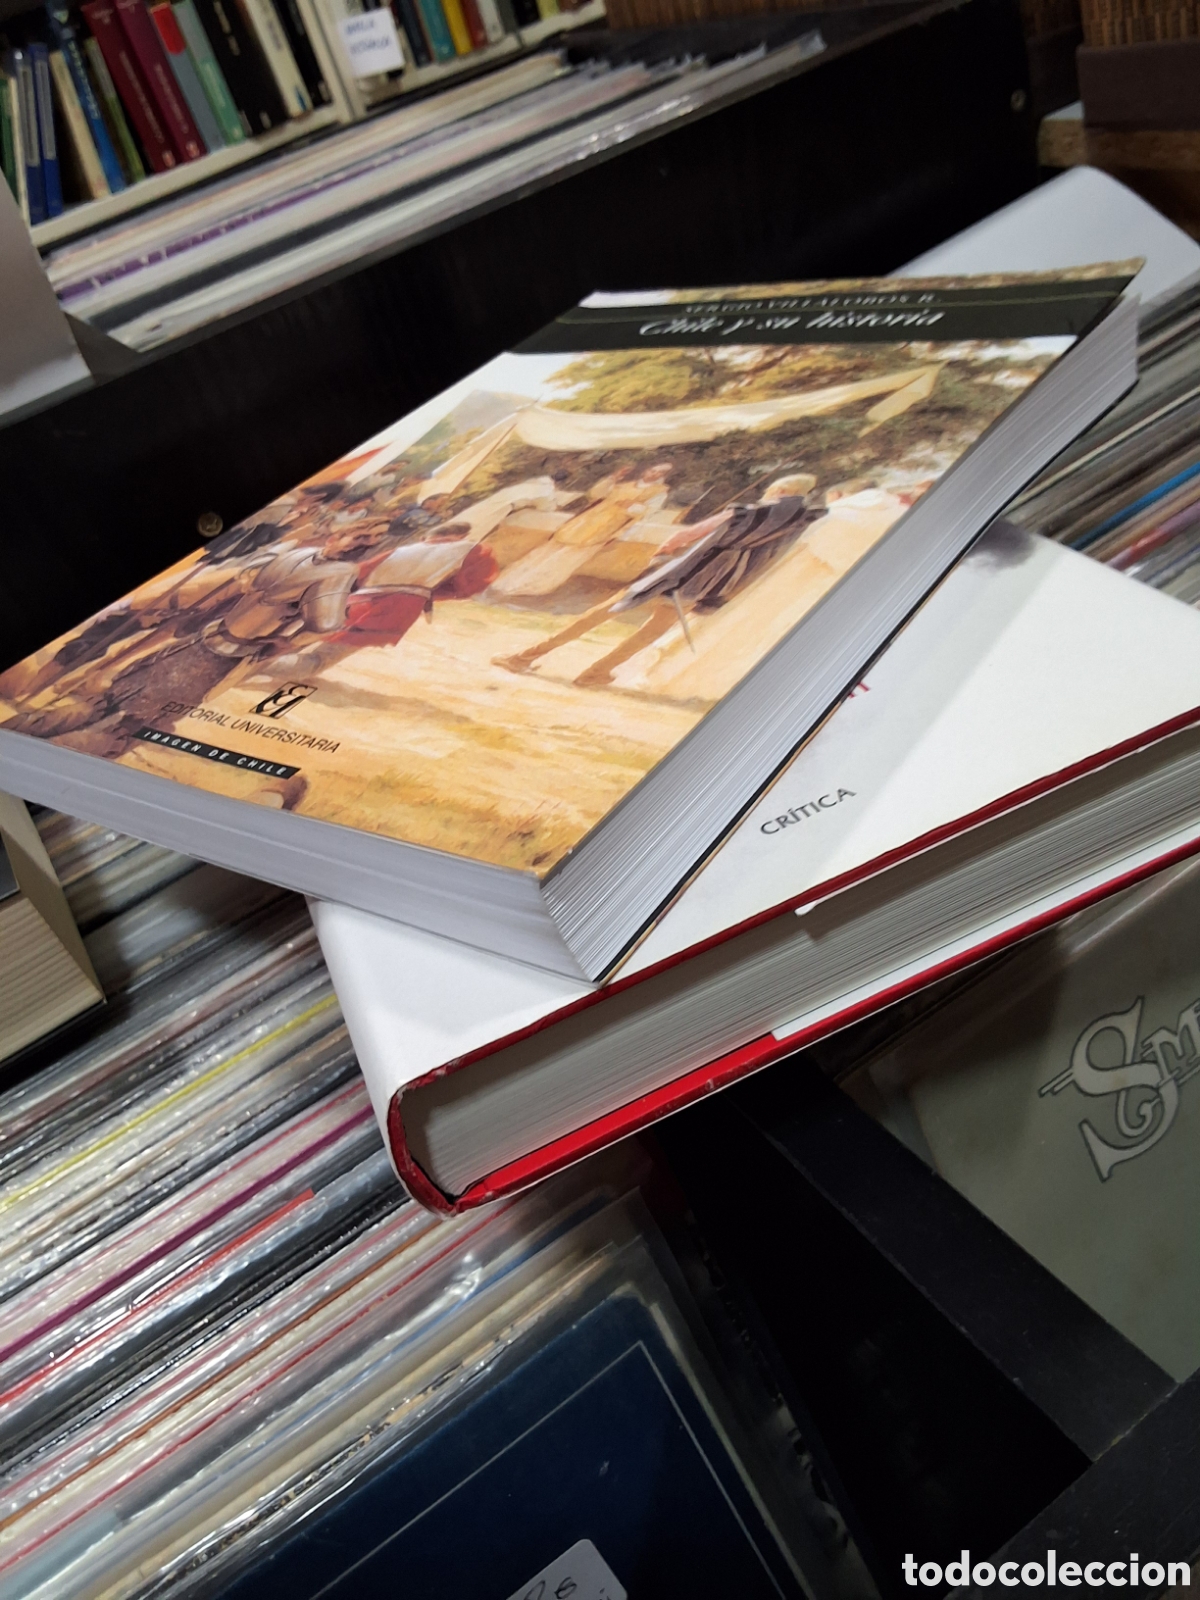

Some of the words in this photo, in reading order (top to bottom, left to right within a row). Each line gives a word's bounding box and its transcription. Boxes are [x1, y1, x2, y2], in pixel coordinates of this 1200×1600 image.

[639, 316, 725, 336] Chile
[755, 314, 801, 331] su
[804, 307, 945, 330] historia
[161, 701, 231, 728] EDITORIAL
[230, 718, 341, 754] UNIVERSITARIA
[143, 730, 203, 753] IMAGEN
[208, 748, 230, 761] DE
[236, 756, 288, 776] CHILE
[760, 787, 857, 835] CRÍTICA
